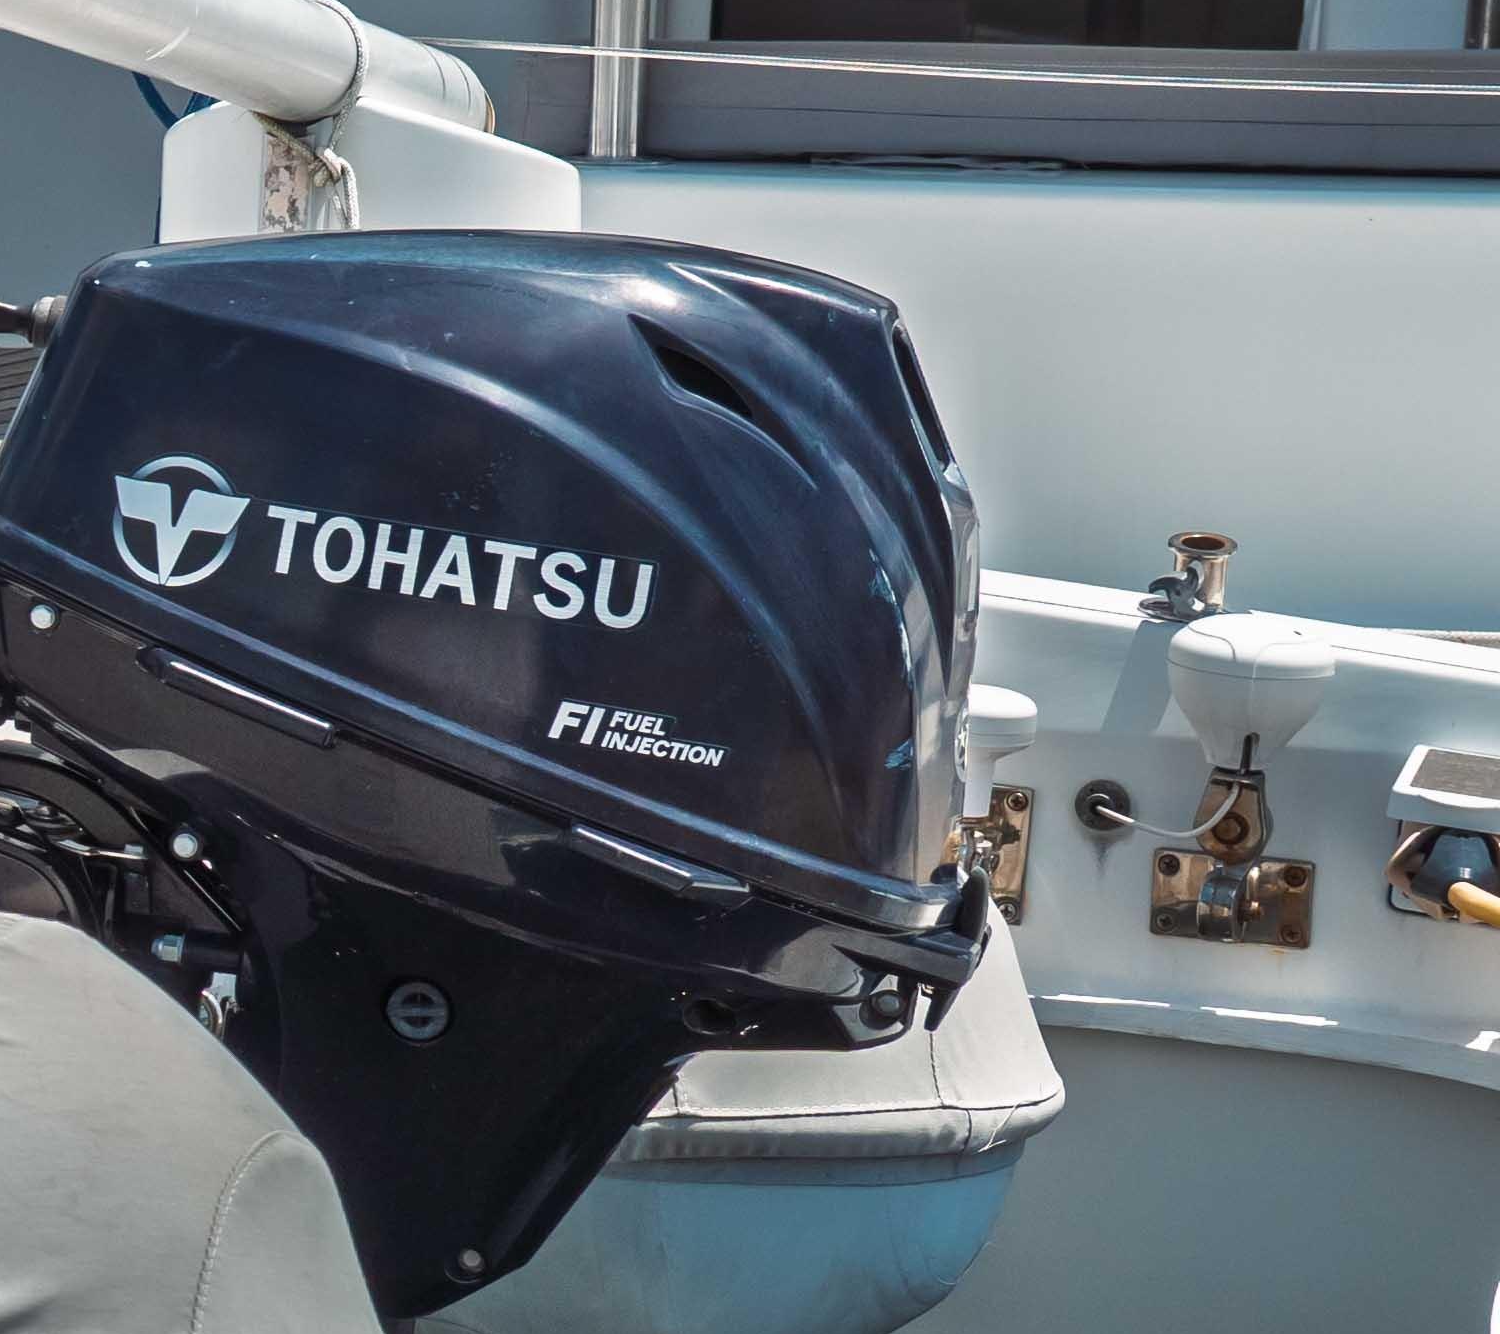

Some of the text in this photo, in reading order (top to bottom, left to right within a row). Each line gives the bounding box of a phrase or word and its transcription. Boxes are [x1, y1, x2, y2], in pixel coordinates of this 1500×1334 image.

[267, 505, 655, 629] TOHATSU
[609, 711, 666, 736] FUEL
[601, 731, 724, 767] INJECTION
